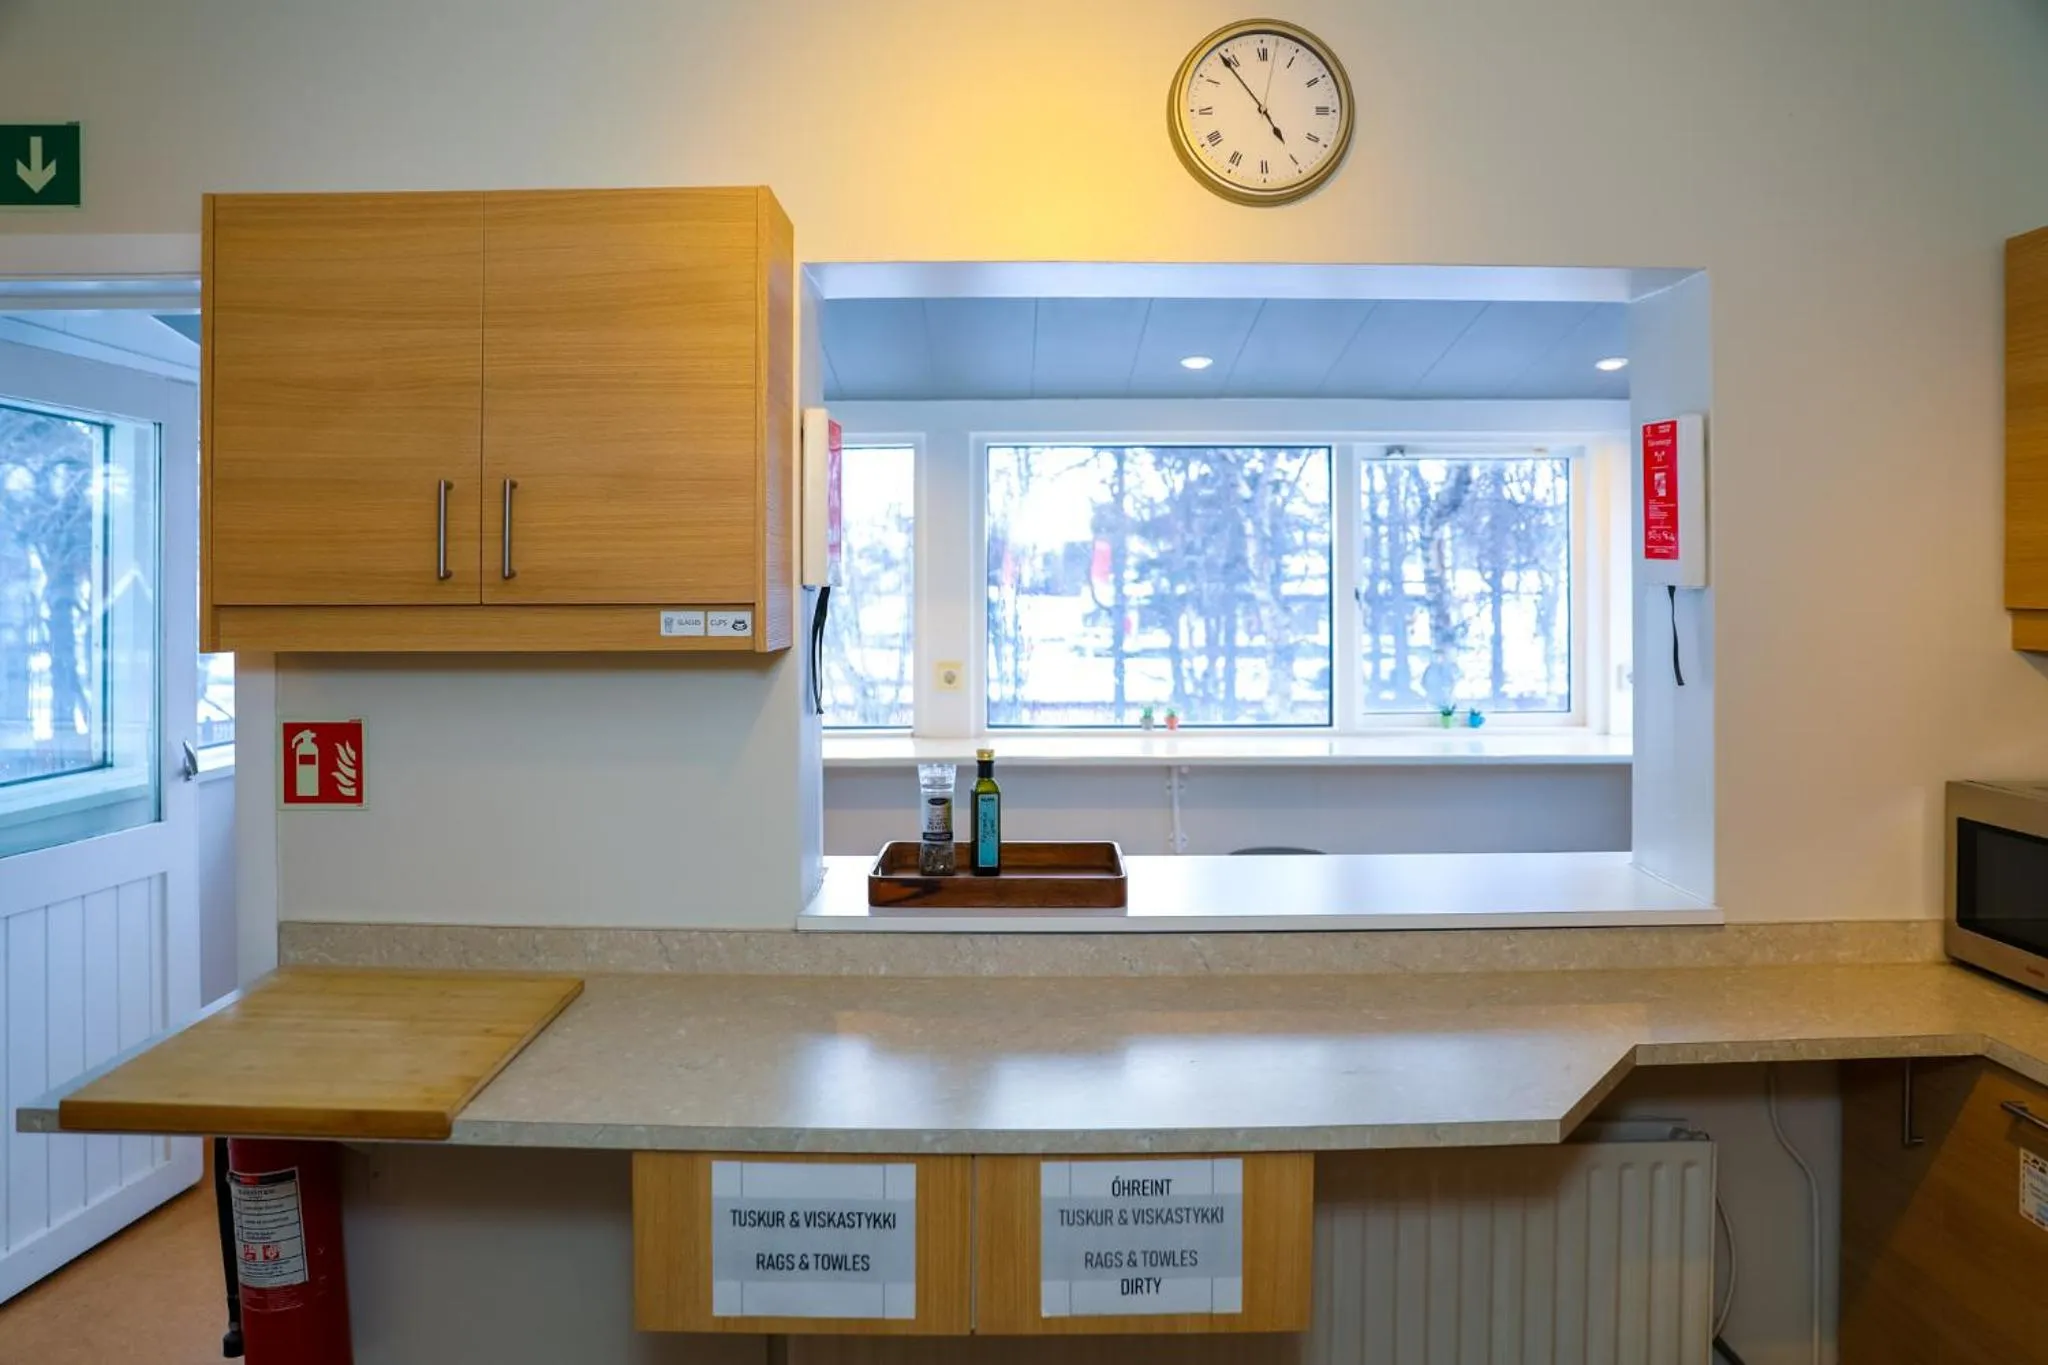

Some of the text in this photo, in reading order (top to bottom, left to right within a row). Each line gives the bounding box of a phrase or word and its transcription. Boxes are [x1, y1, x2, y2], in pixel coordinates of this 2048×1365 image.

[710, 618, 728, 627] CUPS
[1112, 1176, 1172, 1197] ÓHREINT
[730, 1209, 896, 1229] TUSKUR & VISKASTYKKI
[1059, 1206, 1224, 1226] TUSKUR & VISKASTYKKI
[756, 1253, 870, 1272] RAGS & TOWLES
[1084, 1249, 1198, 1269] RAGS & TOWLES
[1121, 1277, 1162, 1295] DIRTY
